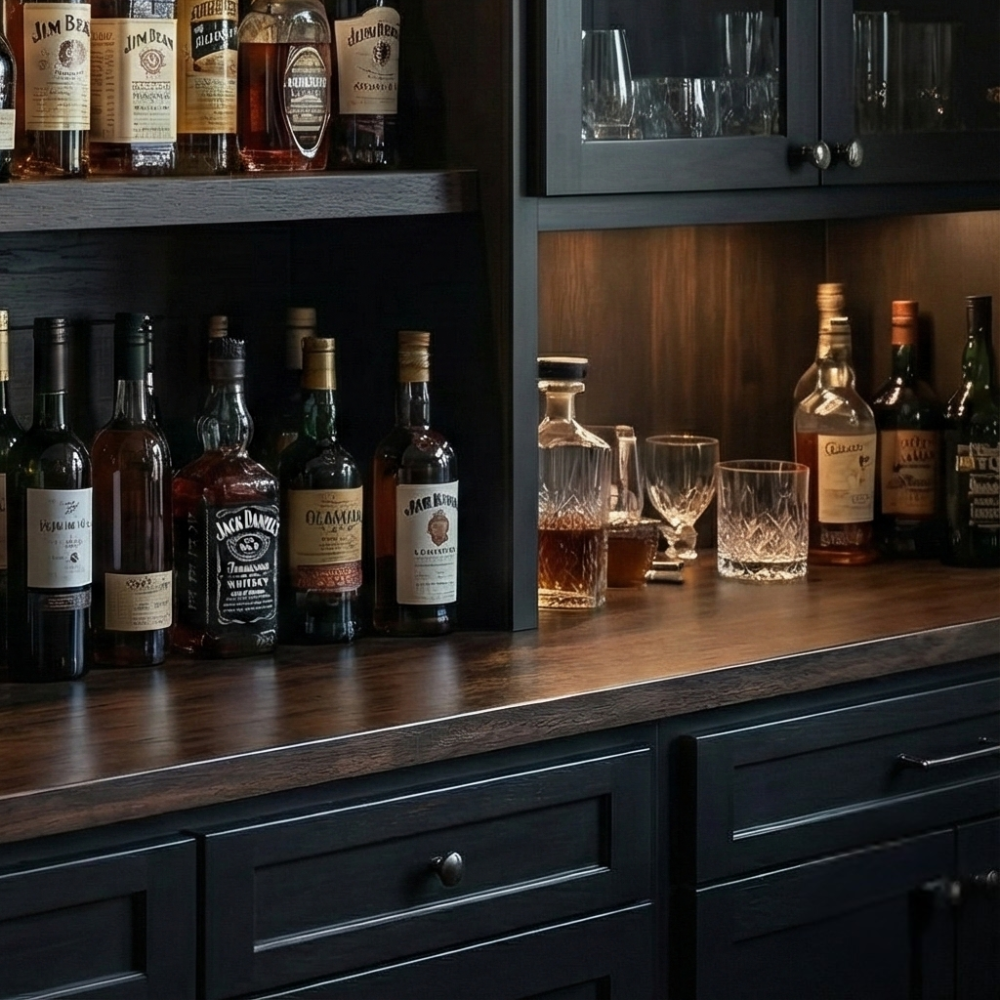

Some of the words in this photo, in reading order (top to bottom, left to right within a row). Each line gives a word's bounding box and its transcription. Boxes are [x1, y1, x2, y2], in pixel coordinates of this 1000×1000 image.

[31, 19, 61, 43] JIM
[124, 33, 147, 54] JIM
[215, 515, 244, 541] JACK
